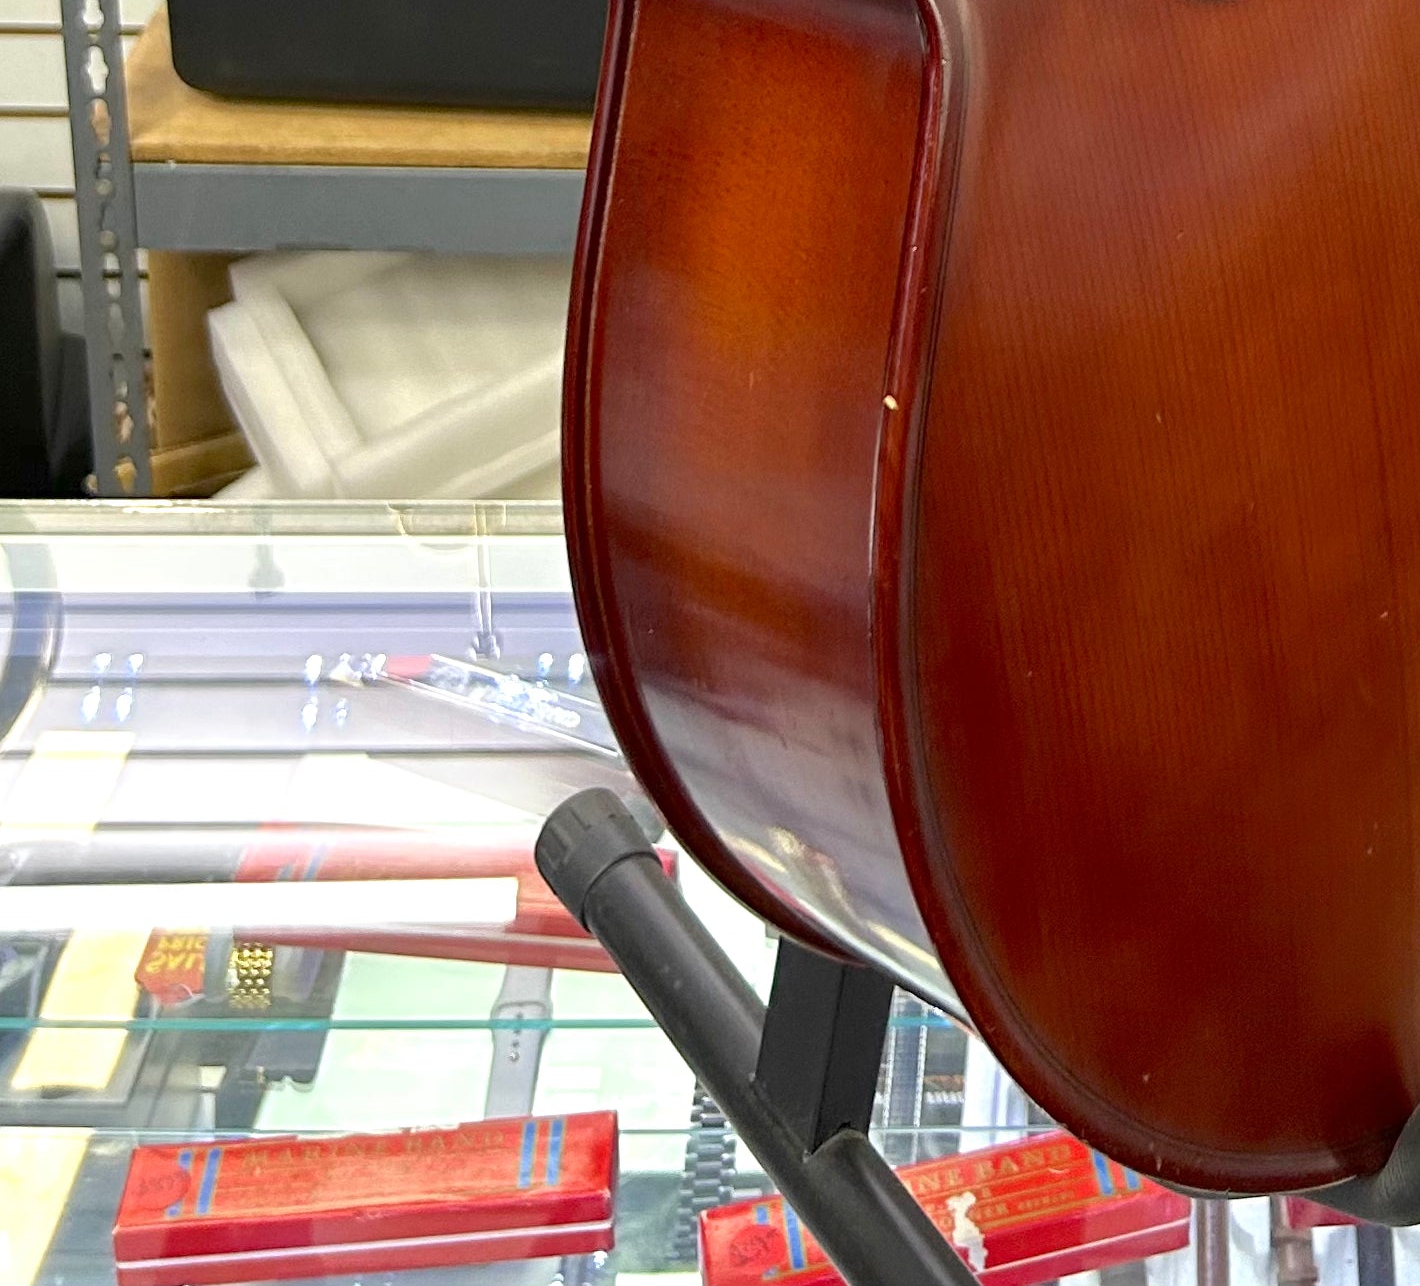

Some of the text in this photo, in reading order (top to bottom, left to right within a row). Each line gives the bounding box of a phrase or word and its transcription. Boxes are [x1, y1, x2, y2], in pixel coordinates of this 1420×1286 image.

[241, 1129, 507, 1170] MARINE BAND
[974, 1143, 1074, 1185] BAND
